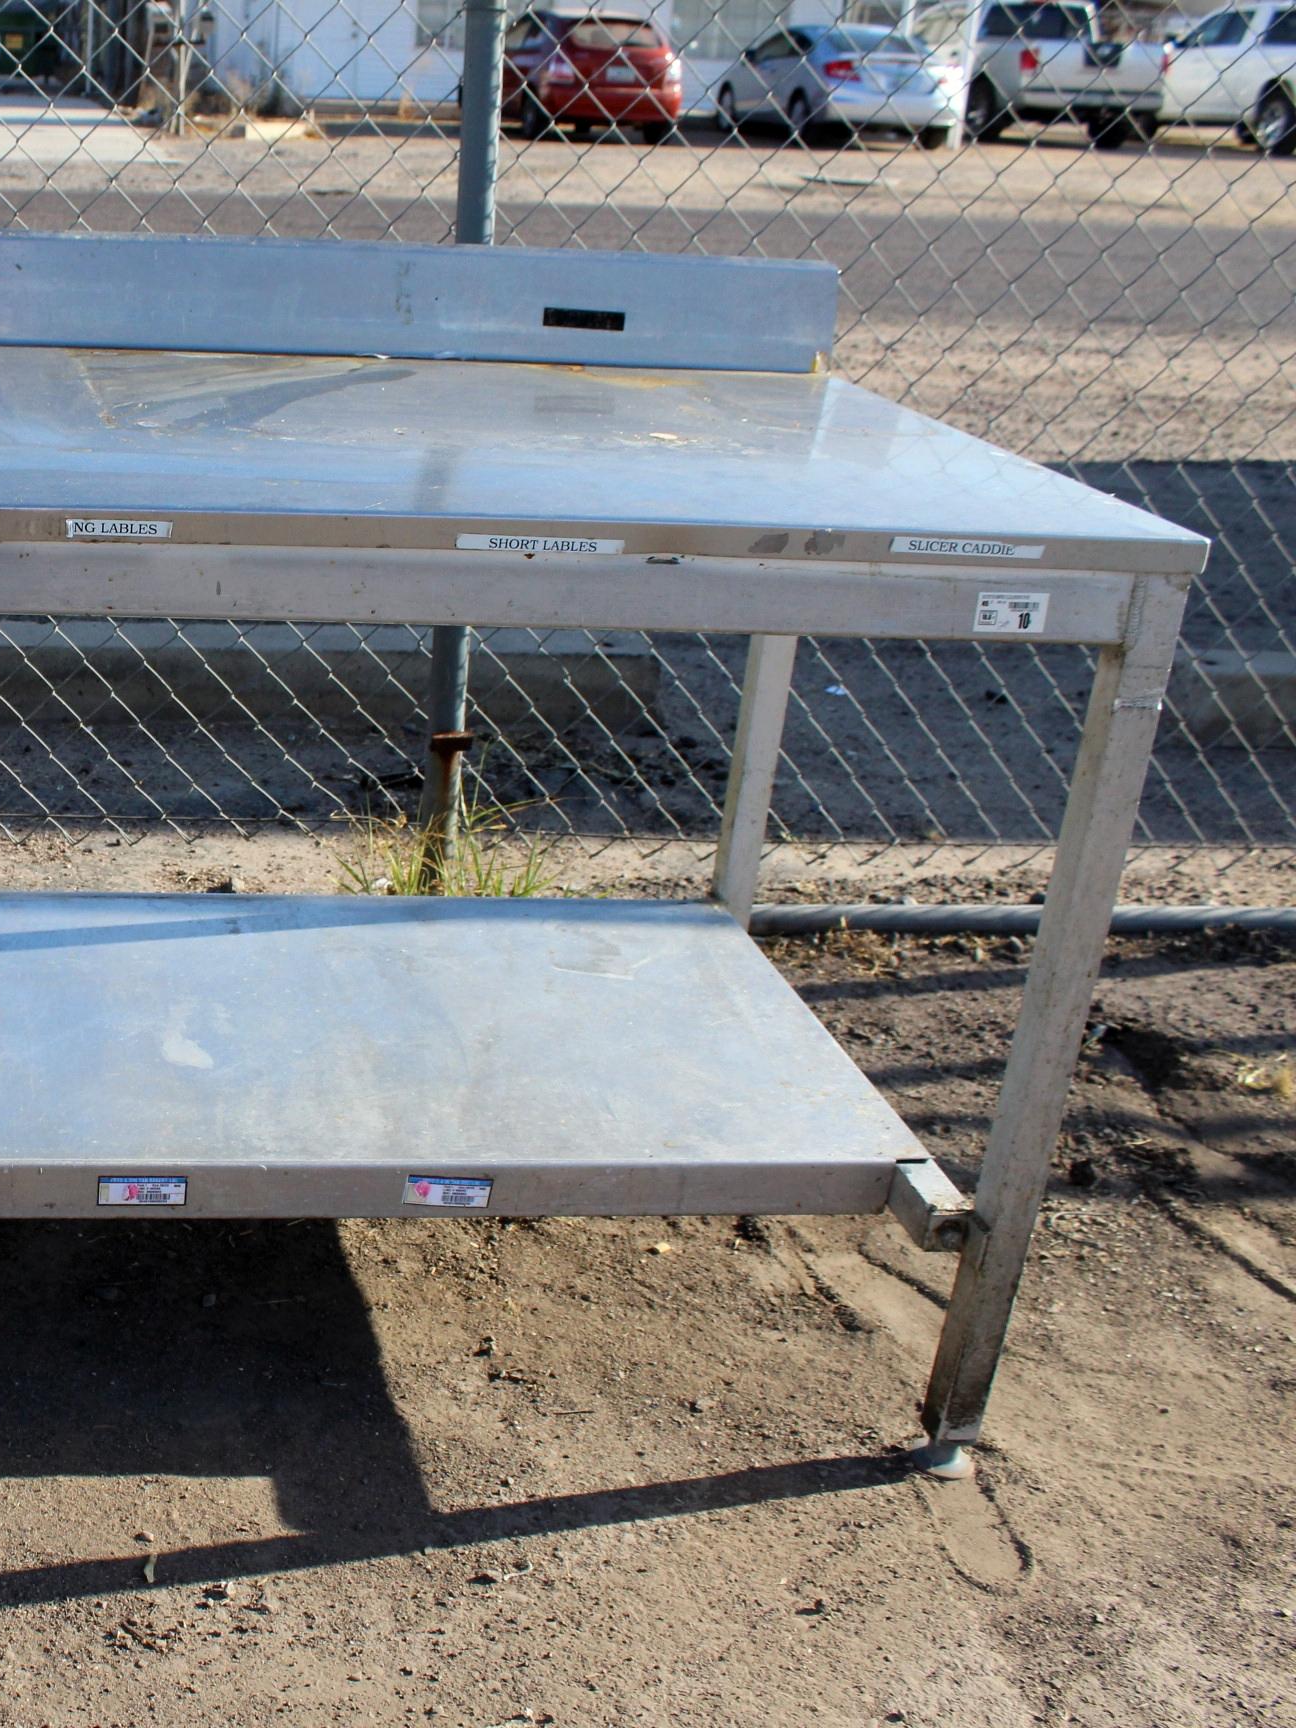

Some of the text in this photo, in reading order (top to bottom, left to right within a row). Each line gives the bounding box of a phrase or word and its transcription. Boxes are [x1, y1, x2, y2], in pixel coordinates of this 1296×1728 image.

[73, 522, 158, 535] NG LABLES
[488, 537, 598, 553] SHORT LABLES
[908, 540, 1015, 556] SLICER CADDIE
